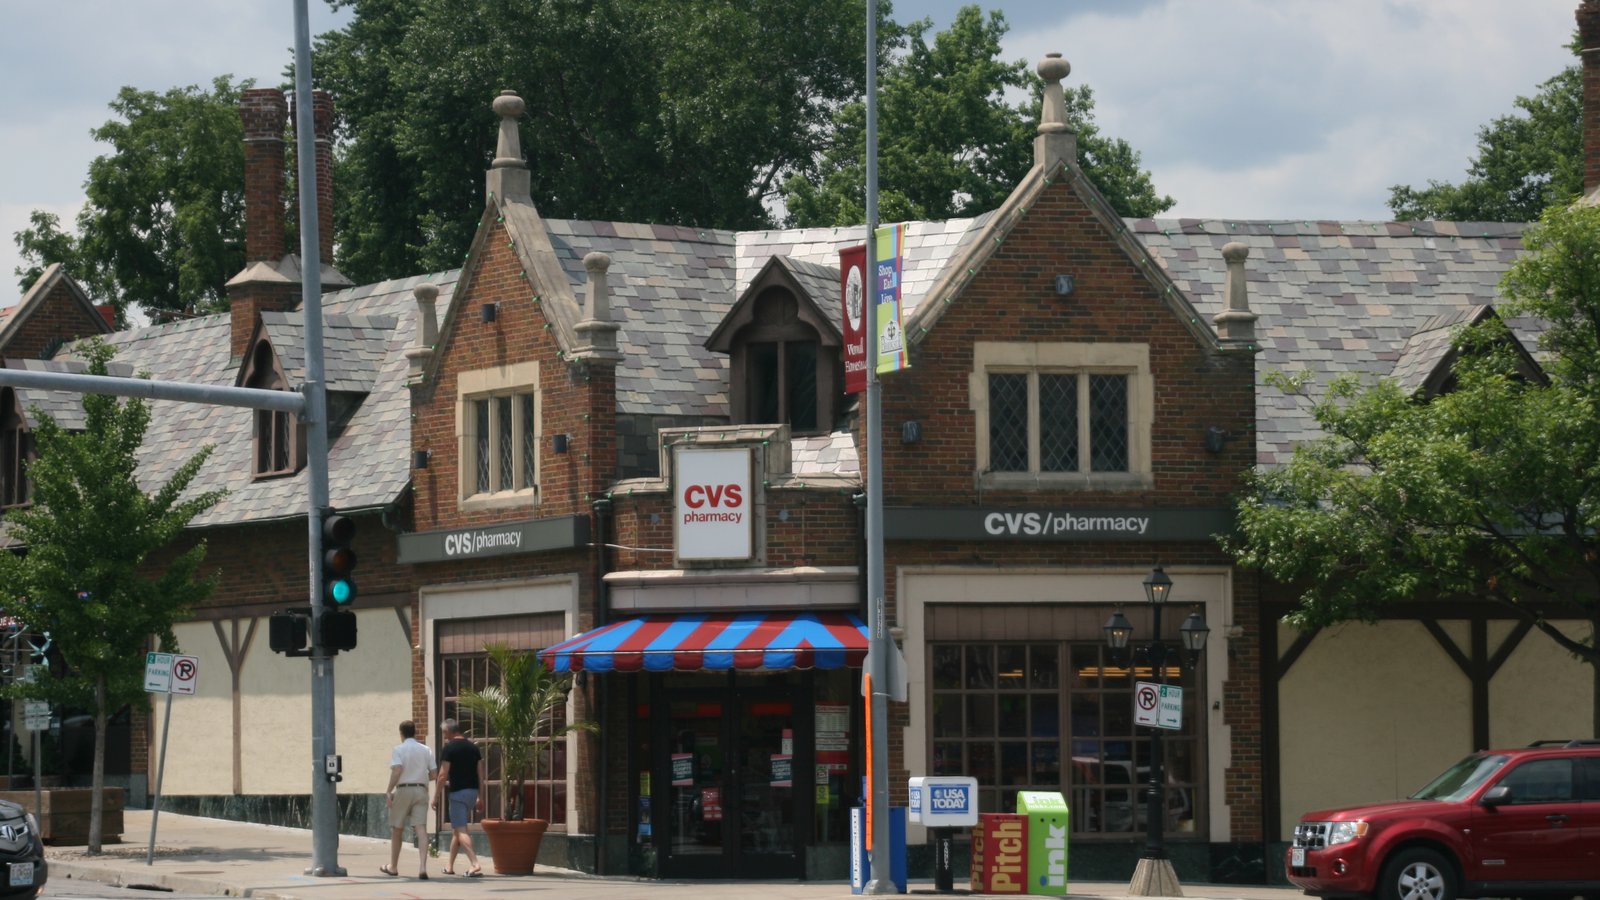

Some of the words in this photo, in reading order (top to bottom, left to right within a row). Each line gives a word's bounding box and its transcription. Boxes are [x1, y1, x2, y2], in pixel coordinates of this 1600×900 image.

[684, 484, 743, 509] CVS
[684, 511, 742, 524] pharmacy
[984, 512, 1149, 535] CVS/pharmacy
[445, 531, 521, 556] CVS/pharmacy
[148, 668, 170, 677] PARKING
[1161, 702, 1180, 712] PARKING
[932, 798, 966, 808] TODAY
[943, 788, 965, 798] USA
[971, 820, 984, 891] Pitch
[991, 822, 1022, 892] Pitch
[1039, 823, 1066, 887] ink
